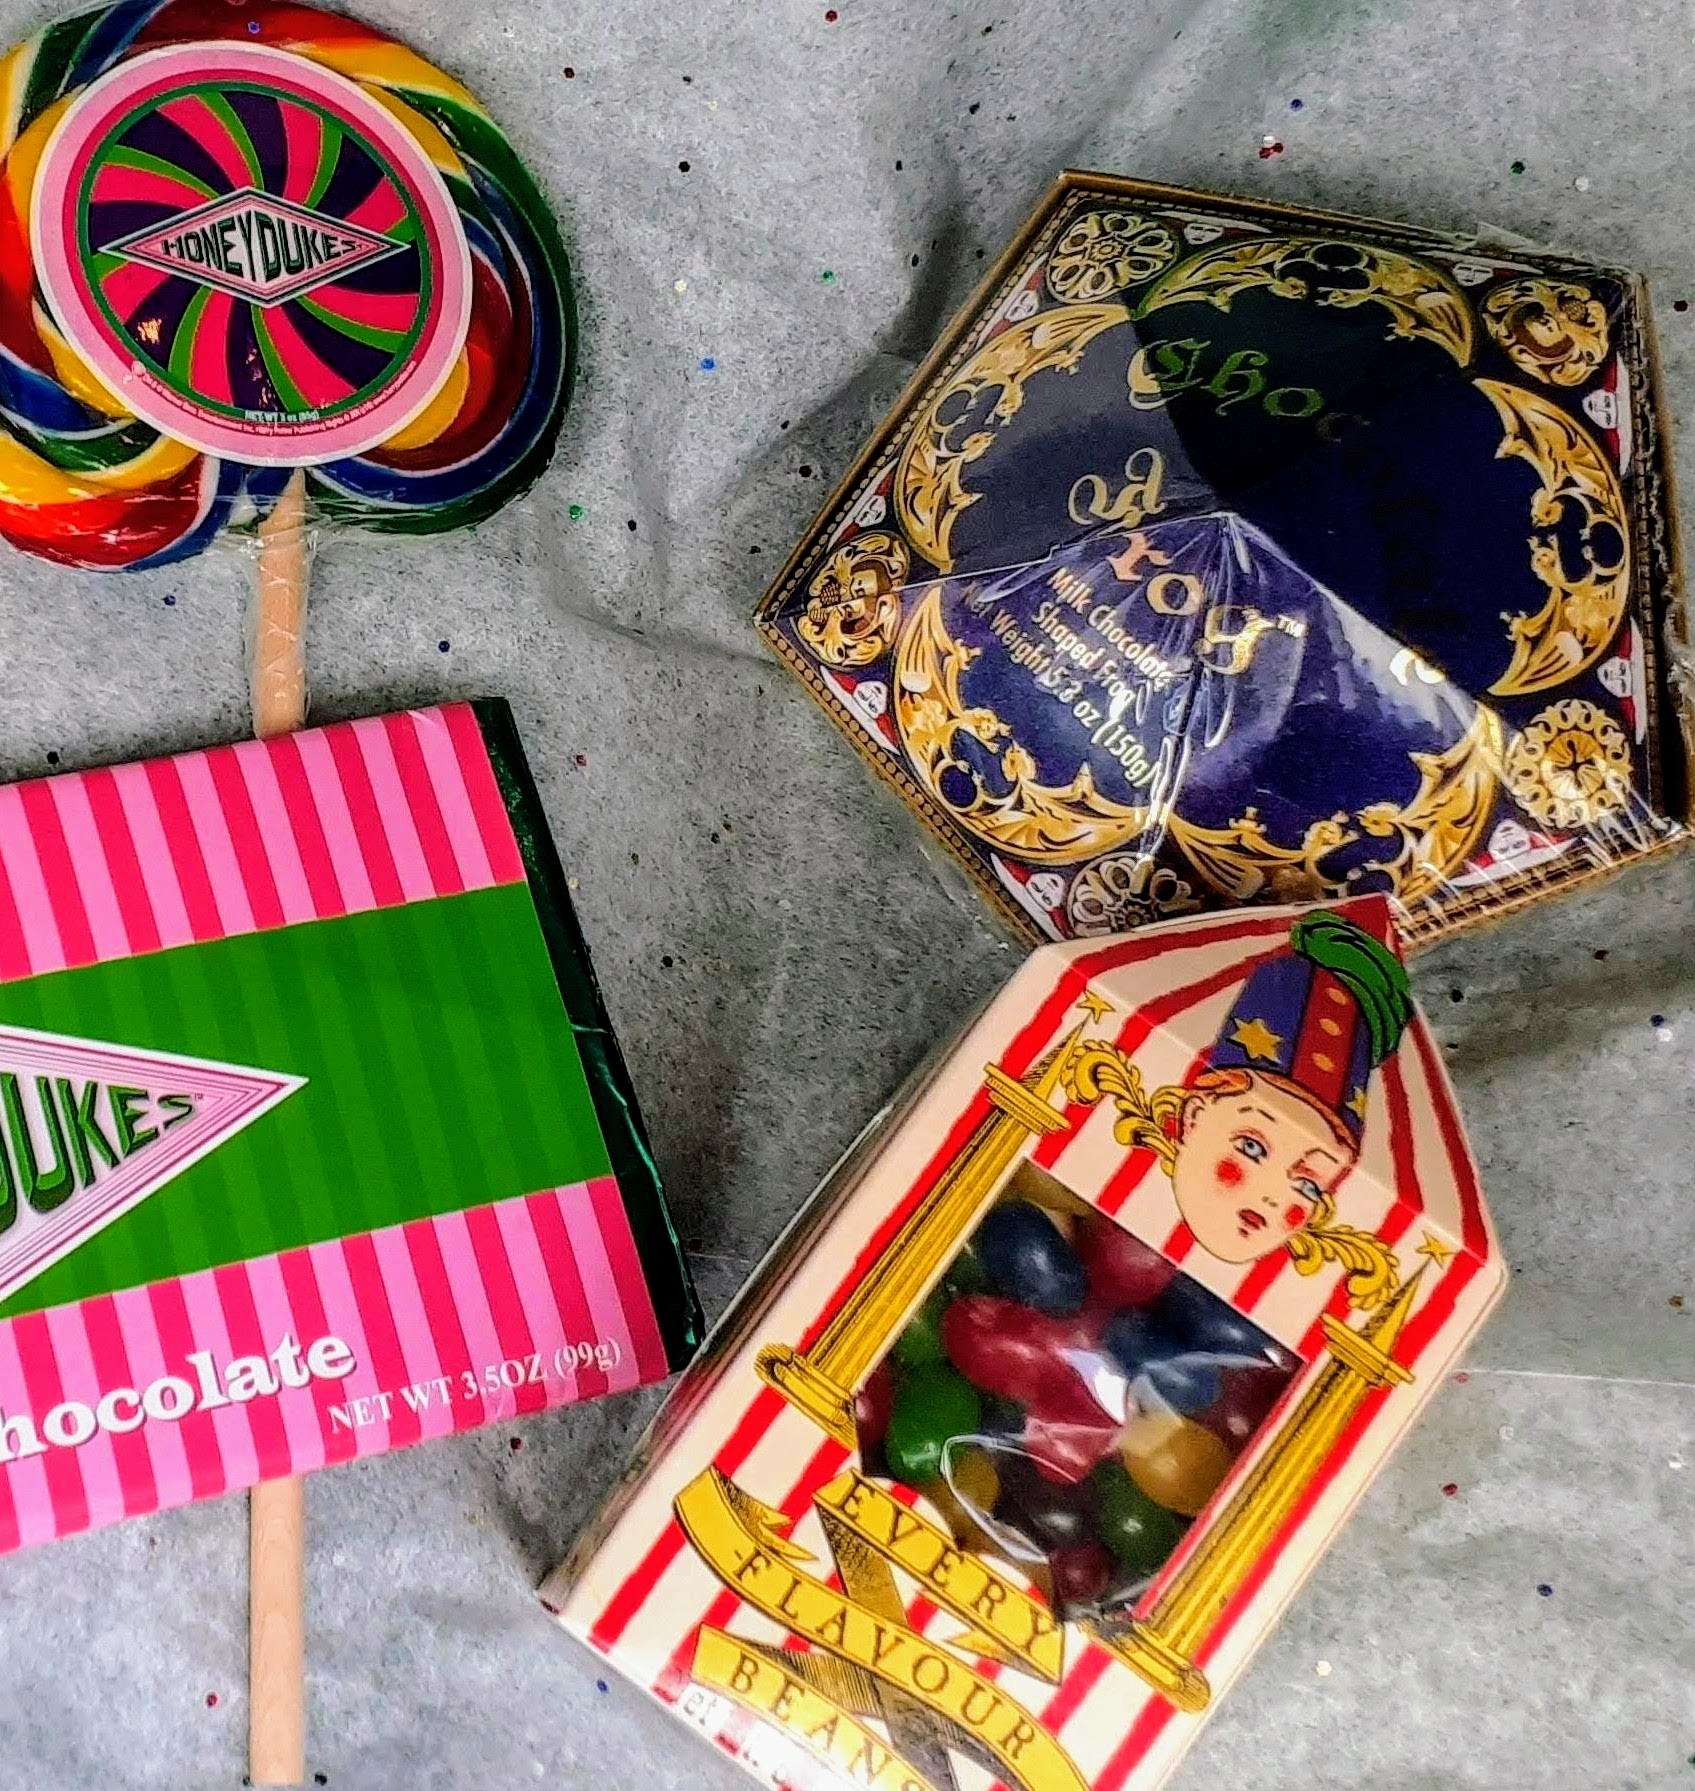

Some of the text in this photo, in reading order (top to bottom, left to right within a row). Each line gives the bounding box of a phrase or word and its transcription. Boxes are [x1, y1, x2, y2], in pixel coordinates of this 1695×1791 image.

[161, 210, 358, 283] HONEYDUKES
[1031, 601, 1105, 669] Shaped
[1047, 567, 1093, 615] Milk
[989, 608, 1052, 675] Weight
[1072, 700, 1101, 728] oz
[1090, 719, 1163, 787] (150g)
[328, 1336, 622, 1435] NET WT 3.5OZ (99g)
[836, 1485, 1059, 1662] EVERY
[732, 1549, 1036, 1761] FLAVOUR
